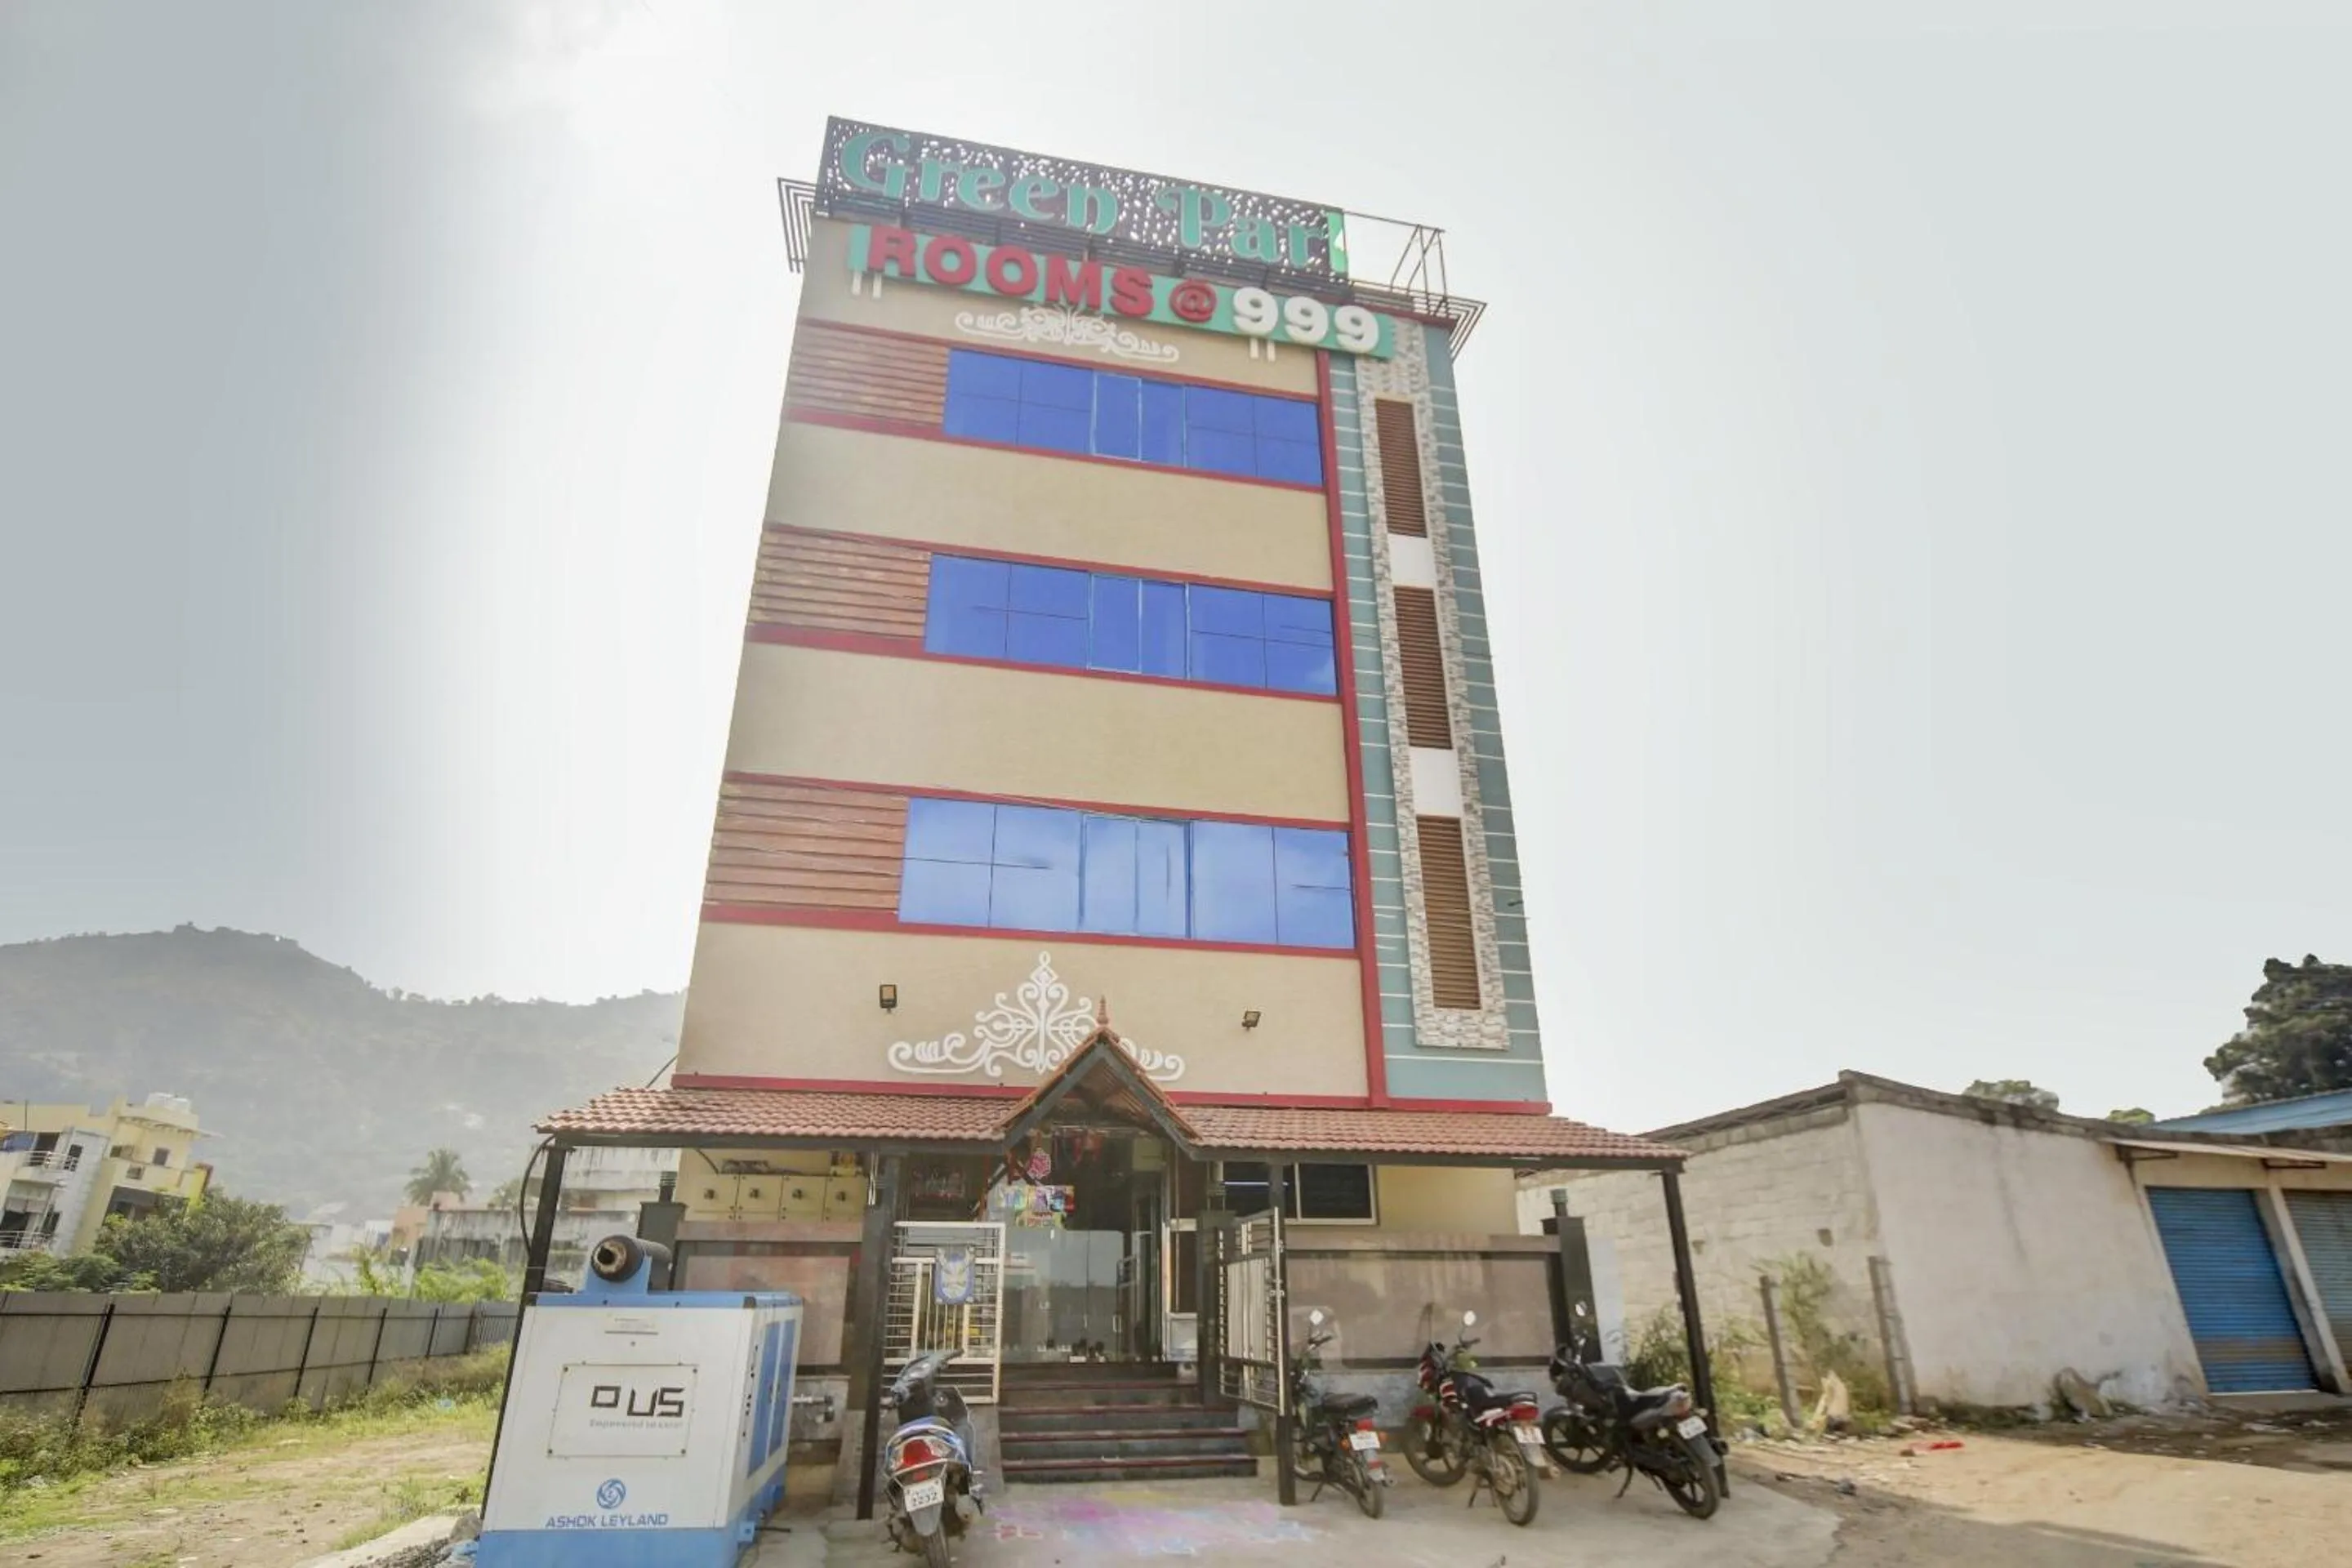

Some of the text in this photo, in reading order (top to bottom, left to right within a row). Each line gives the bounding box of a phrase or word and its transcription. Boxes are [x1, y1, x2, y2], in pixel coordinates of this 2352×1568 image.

[840, 132, 1119, 234] Green
[867, 225, 1154, 317] ROOMS
[1233, 286, 1379, 354] 999
[545, 1512, 669, 1528] ASHOK LEYLAND
